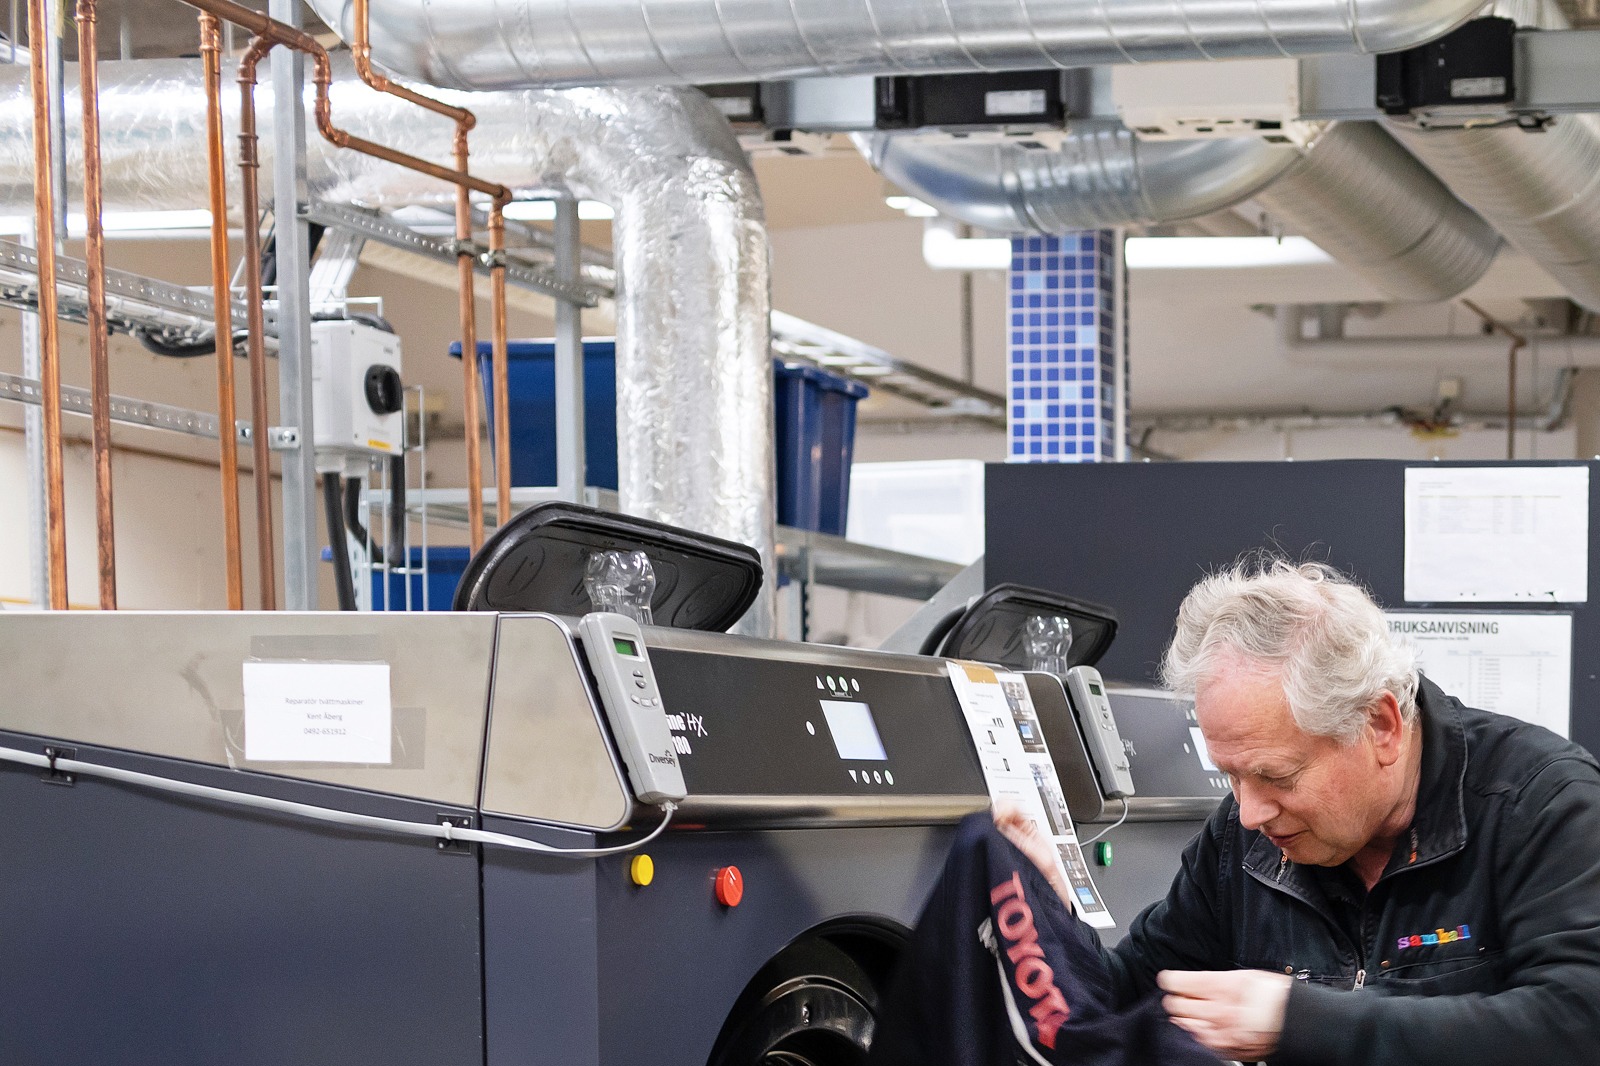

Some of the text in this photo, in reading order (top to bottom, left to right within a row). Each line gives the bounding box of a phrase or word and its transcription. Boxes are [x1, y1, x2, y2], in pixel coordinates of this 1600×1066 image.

[285, 697, 317, 706] Reparatör
[307, 711, 343, 721] Kent Åberg
[686, 712, 709, 738] HX
[648, 752, 676, 768] Diversey
[1397, 924, 1472, 950] samhall
[990, 870, 1071, 1049] TOYOTA
